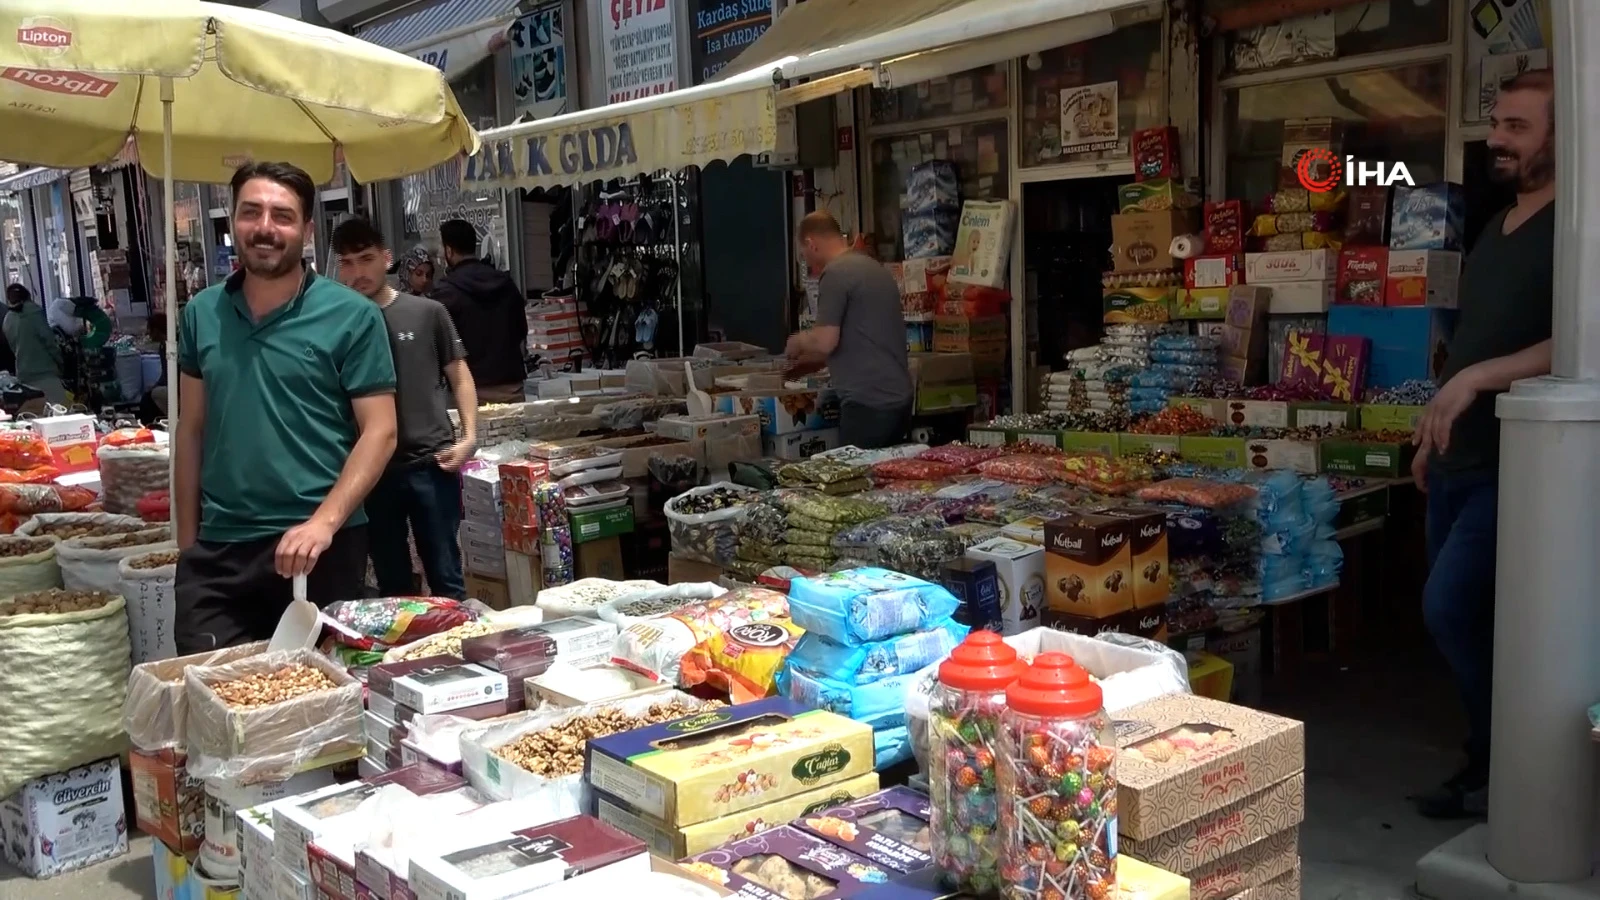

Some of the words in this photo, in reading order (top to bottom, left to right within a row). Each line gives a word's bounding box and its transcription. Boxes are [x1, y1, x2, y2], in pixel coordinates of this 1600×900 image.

[697, 3, 738, 29] Kardaş
[22, 30, 67, 43] Lipton
[559, 122, 638, 174] GIDA
[1053, 533, 1082, 549] Nutball
[1101, 533, 1122, 547] Nutball
[1140, 524, 1161, 538] Nutball
[1140, 616, 1160, 629] Nutball
[1201, 770, 1221, 787] Kuru
[1223, 761, 1245, 777] Pasta
[54, 780, 111, 805] Güvercin
[1196, 821, 1216, 838] Kuru
[1217, 812, 1240, 828] Pasta
[1195, 873, 1215, 890] Kuru
[1216, 863, 1239, 878] Pasta
